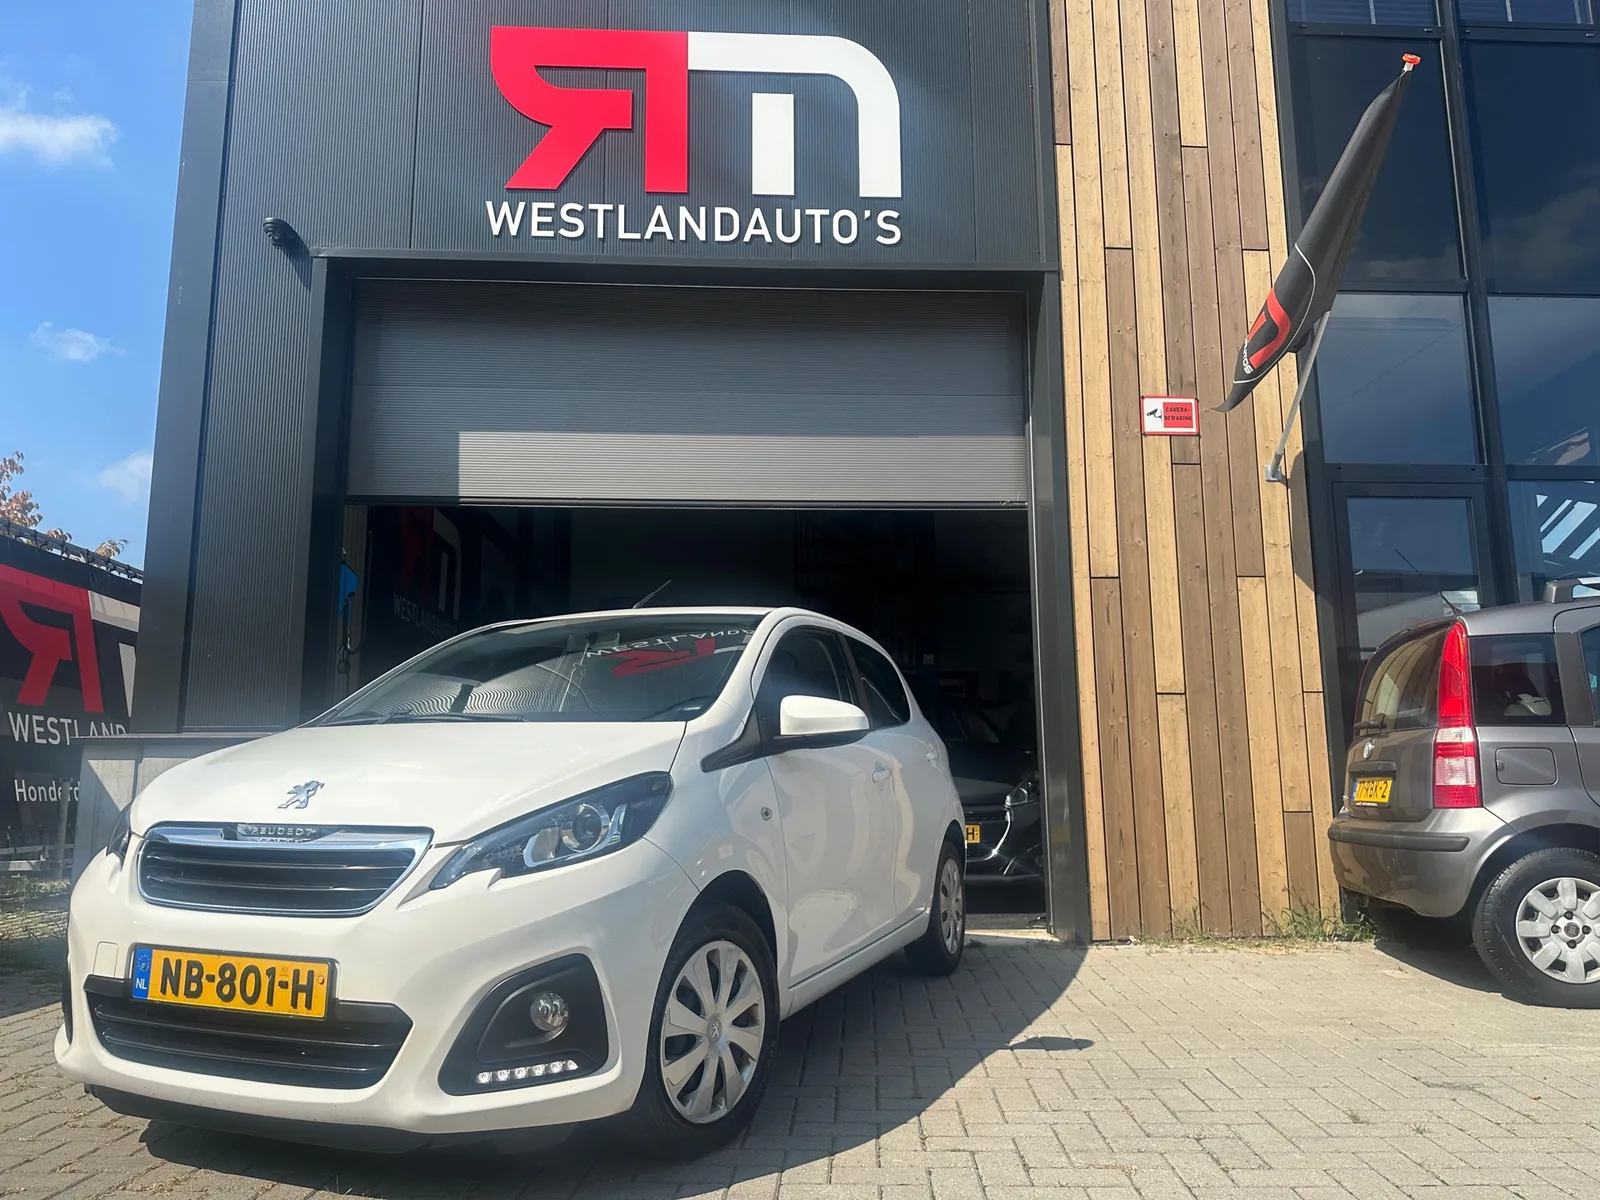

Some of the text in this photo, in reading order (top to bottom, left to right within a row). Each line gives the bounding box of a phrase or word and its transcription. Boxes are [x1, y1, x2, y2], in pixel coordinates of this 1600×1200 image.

[485, 200, 902, 246] WESTLANDAUTO'S
[394, 591, 458, 641] WESTLANDAUTO
[251, 825, 314, 837] PEUGEOT
[135, 977, 147, 990] NL
[159, 956, 315, 1011] NB-801-H
